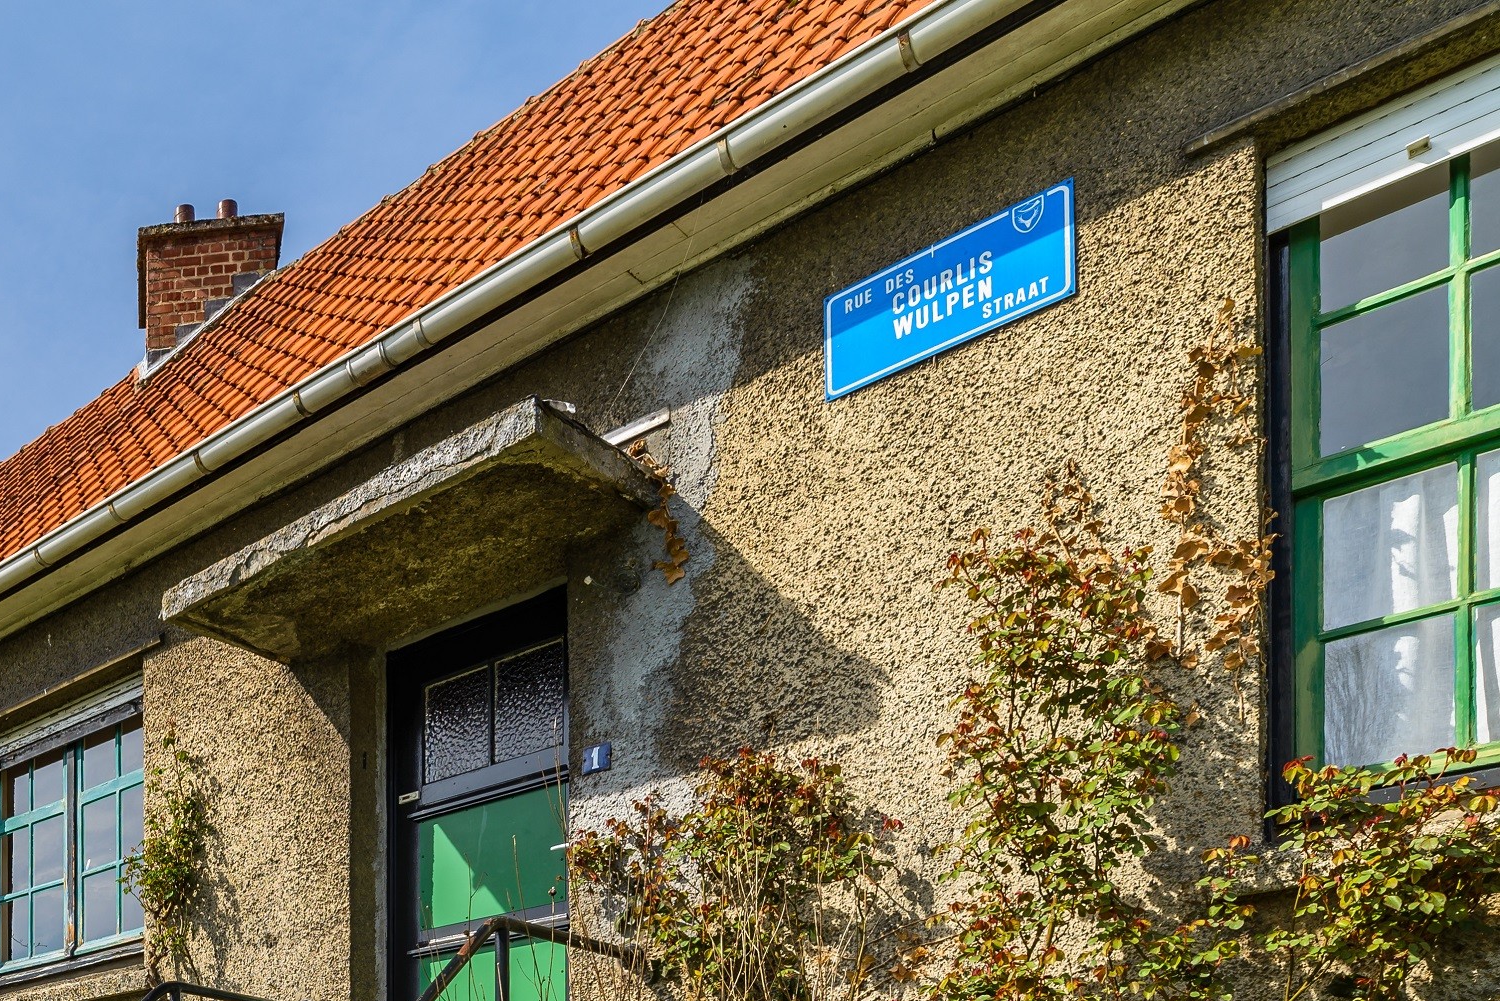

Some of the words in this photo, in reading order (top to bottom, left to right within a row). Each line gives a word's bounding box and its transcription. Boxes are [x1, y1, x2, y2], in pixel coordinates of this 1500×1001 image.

[844, 288, 872, 314] RUE
[885, 268, 915, 295] DES
[892, 251, 993, 315] COURLIS
[982, 276, 1049, 319] STRAAT
[892, 275, 993, 339] WULPEN
[591, 746, 600, 770] 1
